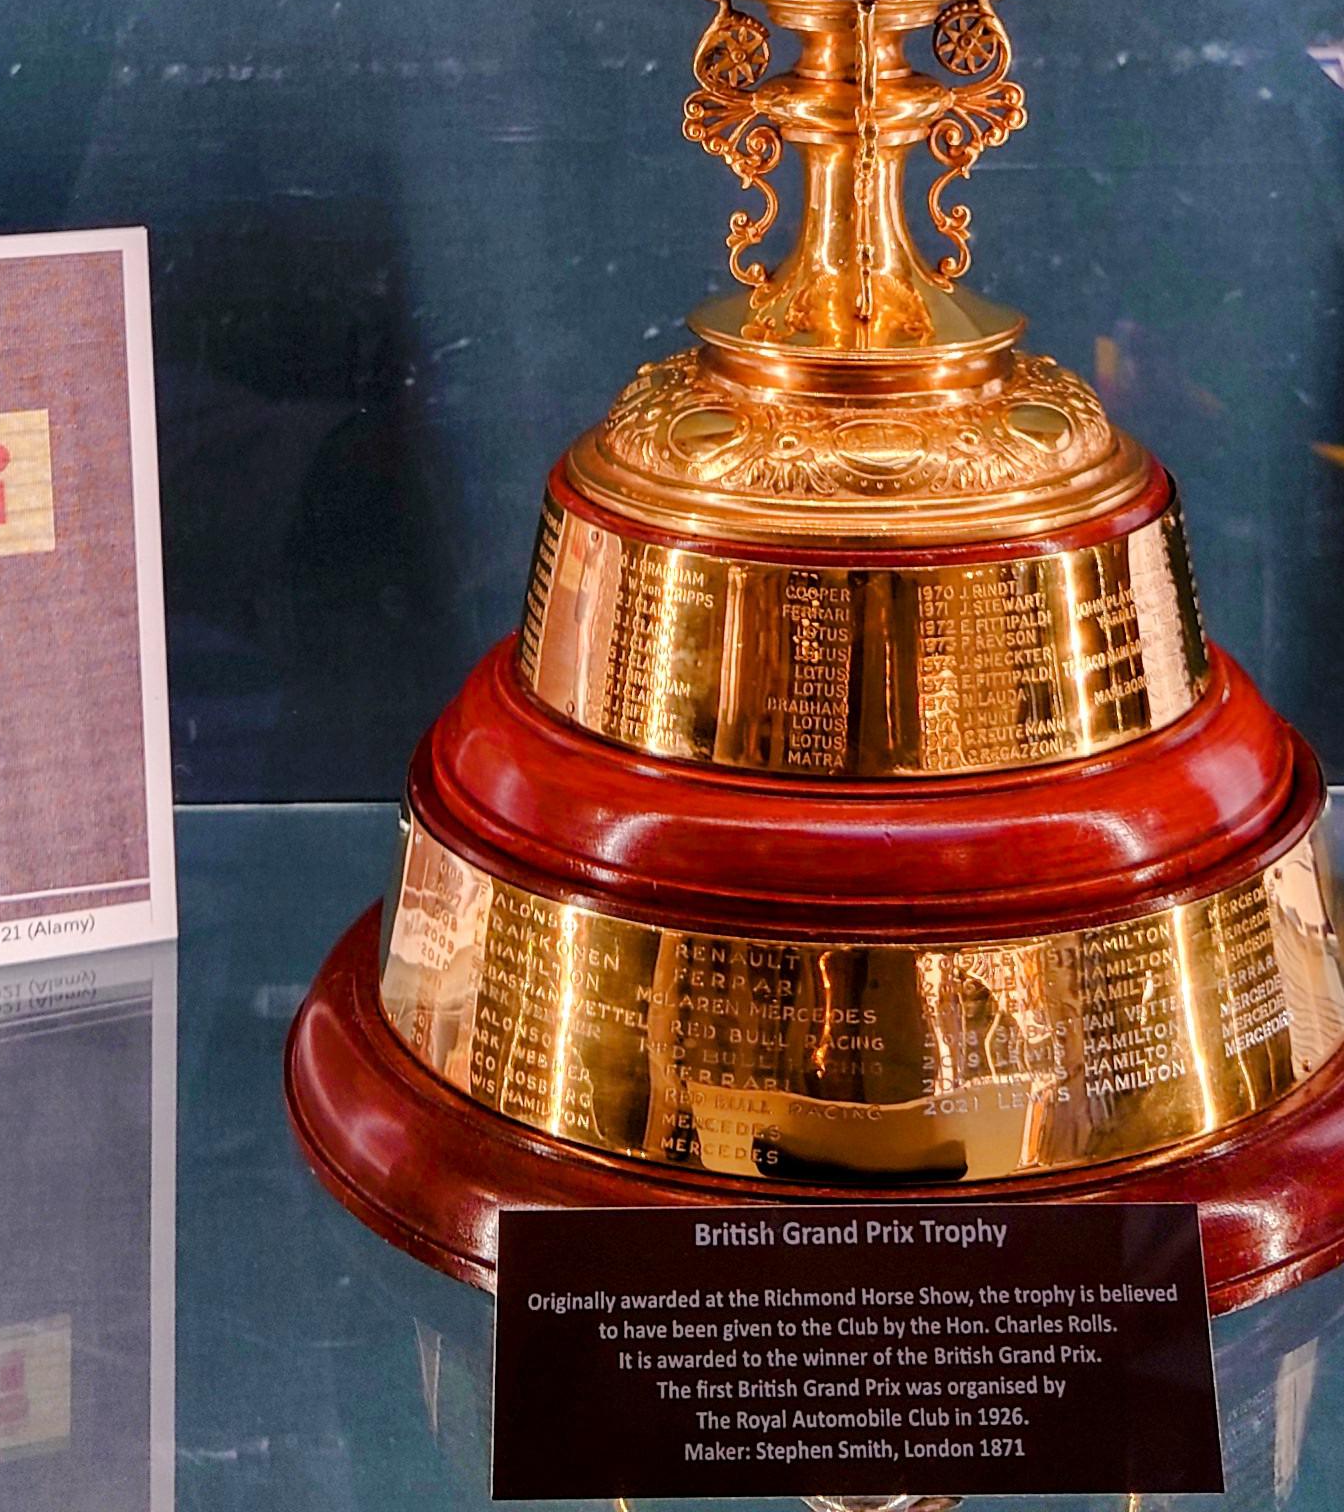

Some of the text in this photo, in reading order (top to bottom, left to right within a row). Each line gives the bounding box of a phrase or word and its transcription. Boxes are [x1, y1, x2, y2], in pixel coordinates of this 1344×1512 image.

[795, 666, 847, 681] LOTUS
[794, 682, 846, 697] LOTUS
[793, 716, 844, 731] LOTUS
[791, 734, 843, 749] LOTUS
[788, 751, 844, 768] MATRA
[26, 914, 95, 941] (Alamy)
[675, 943, 800, 970] RENAULT
[671, 1020, 716, 1039] RED
[730, 1028, 788, 1048] BULL
[998, 1087, 1070, 1110] LEWIS
[1085, 1059, 1185, 1097] HAMILTON
[661, 1136, 779, 1165] MERCEDES
[696, 1218, 1007, 1249] British Grand Prix Trophy
[528, 1283, 1177, 1315] Originally awarded at the Richmond Horse Show, the trophy is believed
[599, 1313, 1117, 1342] to have been given to the Club by the Hon. Charles Rolls.
[620, 1344, 1101, 1370] It is awarded to the winner of the British Grand Prix.
[656, 1375, 1066, 1400] The first British Grand Prix was organised by
[696, 1407, 1029, 1433] The Royal Automobile Club in 1926.
[685, 1438, 1025, 1464] Maker: Stephen Smith, London 1871
